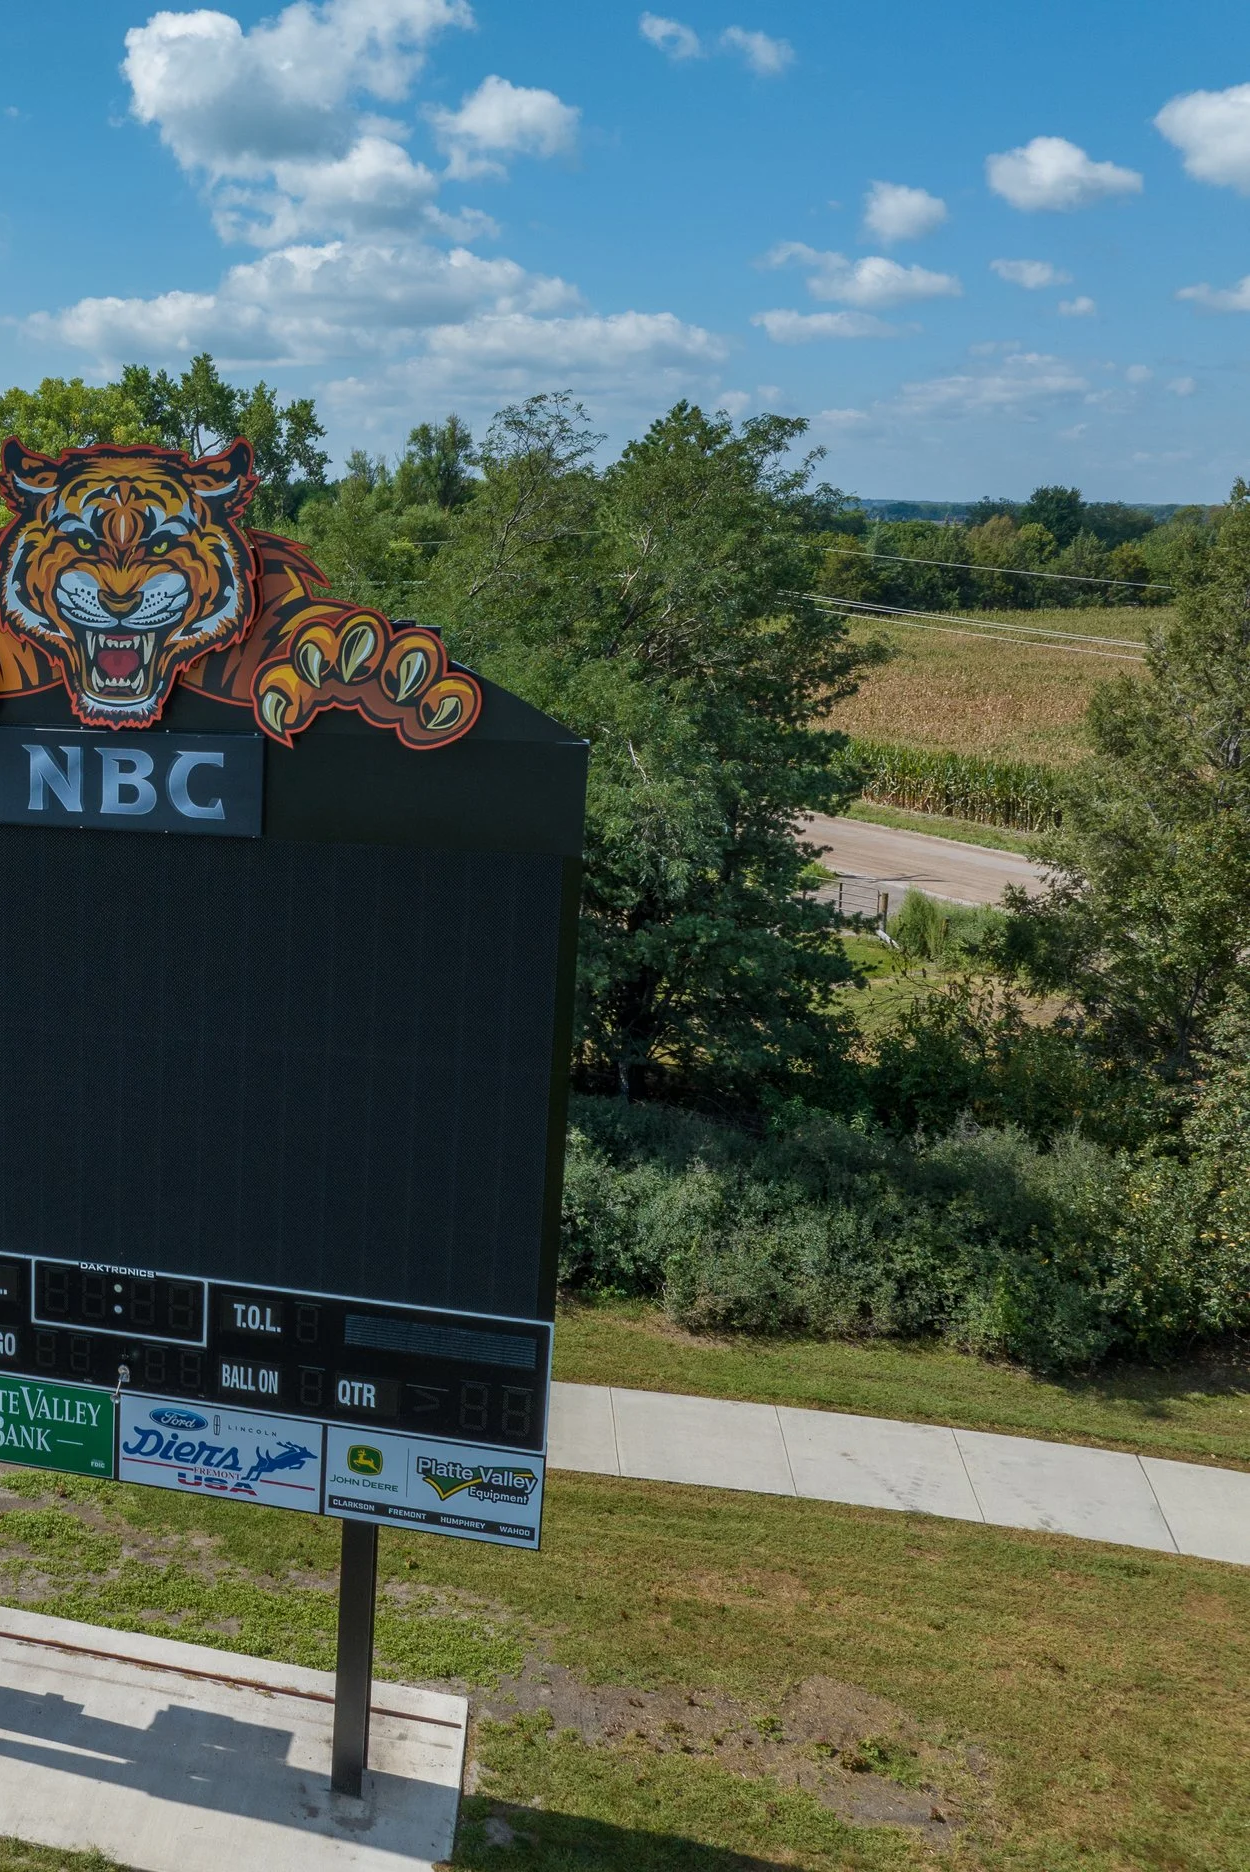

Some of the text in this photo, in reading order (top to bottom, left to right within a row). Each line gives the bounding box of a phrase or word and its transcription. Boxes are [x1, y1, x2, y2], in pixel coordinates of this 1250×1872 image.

[21, 744, 226, 820] NBC
[80, 1262, 155, 1278] DAKTRONICS
[234, 1303, 282, 1333] T.O.L.
[221, 1363, 279, 1395] BALL ON
[338, 1380, 376, 1408] QTR
[161, 1411, 196, 1428] Ford
[227, 1424, 278, 1437] LINCOLN
[122, 1426, 243, 1472] Diers
[90, 1461, 106, 1469] FDIC
[193, 1466, 242, 1481] FREMONT
[418, 1457, 537, 1494] Platte Valley
[177, 1472, 258, 1497] USA
[330, 1474, 399, 1493] JOHN DEERE
[469, 1486, 528, 1505] Equipment
[332, 1498, 530, 1537] CLARKSON FREMONT HUMPHREY WAHOO
